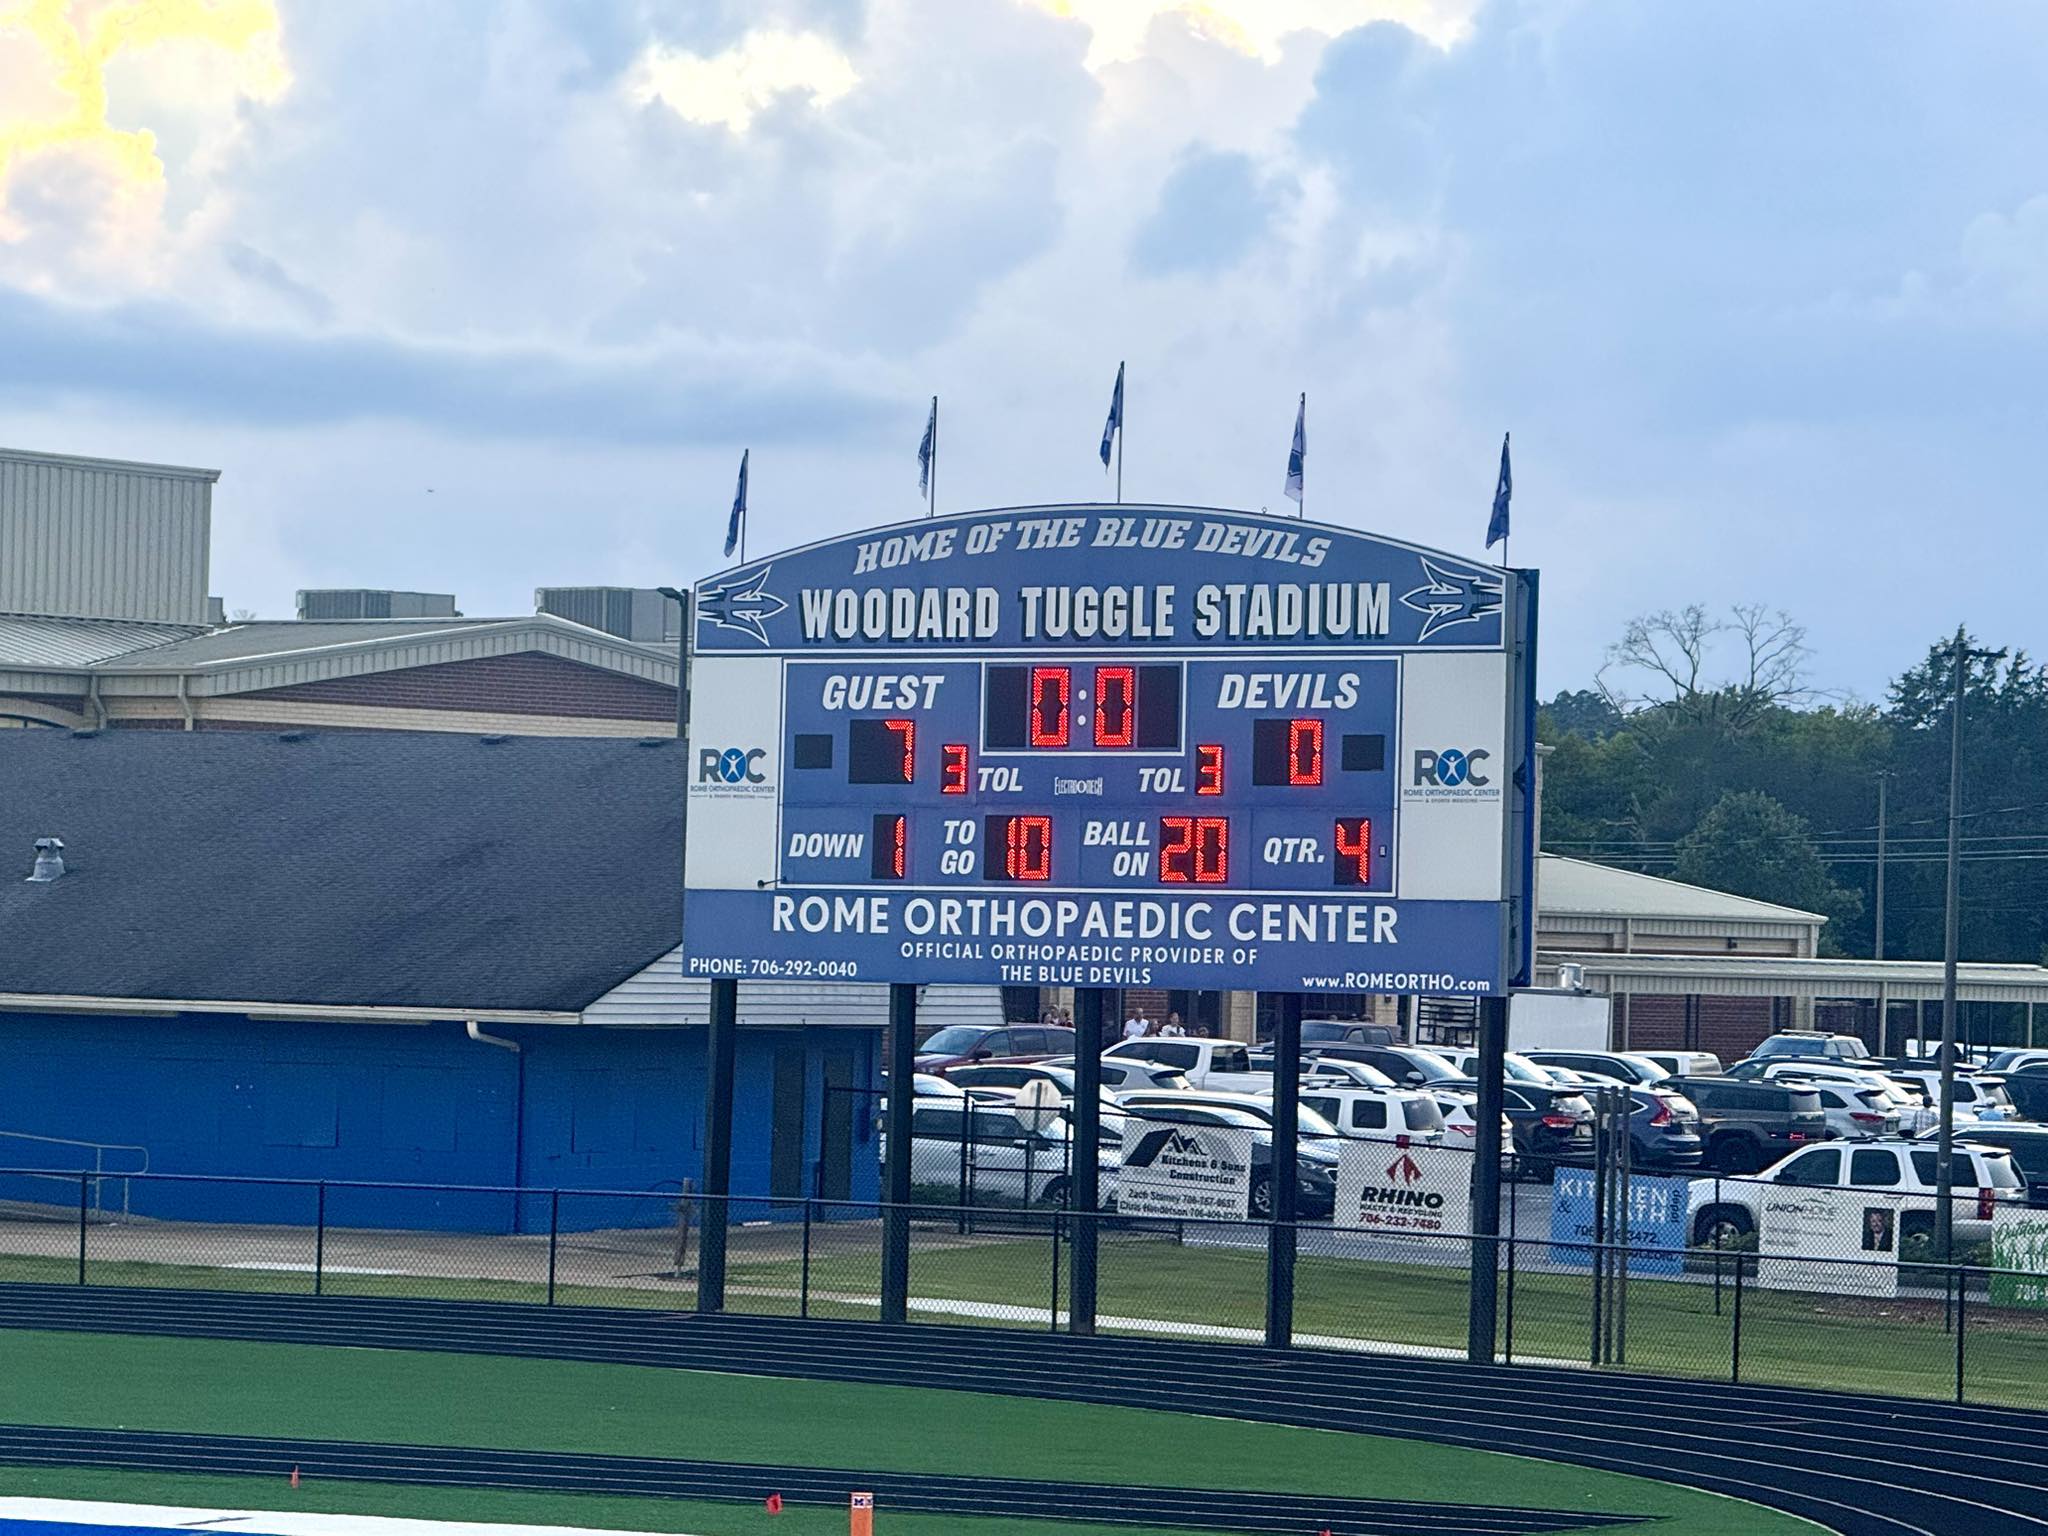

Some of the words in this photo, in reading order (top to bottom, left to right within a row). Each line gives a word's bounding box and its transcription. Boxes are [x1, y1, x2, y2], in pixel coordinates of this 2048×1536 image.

[853, 528, 956, 575] HOME
[965, 522, 1011, 555] OF
[1016, 517, 1087, 550] THE
[1091, 518, 1193, 549] BLUE
[1193, 522, 1332, 567] DEVILS
[802, 586, 999, 639] WOODARD
[1021, 585, 1174, 638] TUGGLE
[1196, 583, 1390, 637] STADIUM
[822, 675, 945, 711] GUEST
[1217, 673, 1360, 709] DEVILS
[884, 719, 915, 782] 7
[1289, 719, 1324, 785] 0
[699, 748, 766, 783] ROC
[942, 745, 968, 794] 3
[1197, 745, 1223, 795] 3
[1414, 749, 1490, 786] ROC
[978, 767, 1023, 791] TOL
[1138, 767, 1185, 793] TOL
[943, 820, 976, 844] TO
[1083, 822, 1150, 846] BALL
[788, 834, 864, 858] DOWN
[895, 816, 905, 878] 1
[1007, 816, 1052, 880] 10
[1160, 817, 1229, 882] 20
[1263, 838, 1325, 864] QTR.
[1335, 819, 1370, 884] 4
[941, 850, 975, 875] GO
[1112, 852, 1149, 876] ON
[772, 895, 889, 934] ROME
[904, 898, 1212, 940] ORTHOPAEDIC
[1229, 903, 1398, 944] CENTER
[901, 942, 983, 959] OFFICIAL
[990, 943, 1123, 962] ORTHOPAEDIC
[1131, 946, 1224, 964] PROVIDER
[1233, 948, 1257, 965] OF
[689, 957, 747, 975] PHONE:
[751, 958, 857, 977] 706-292-0040
[1000, 965, 1032, 981] THE
[1039, 966, 1083, 983] BLUE
[1089, 967, 1151, 984] DEVILS
[1302, 972, 1490, 992] www.ROMEORTHO.com
[1162, 1155, 1207, 1169] Kitchens
[1221, 1160, 1246, 1173] Sons
[1169, 1169, 1236, 1185] Construction
[1361, 1186, 1444, 1209] RHINO
[1397, 1206, 1443, 1218] RECYCLING
